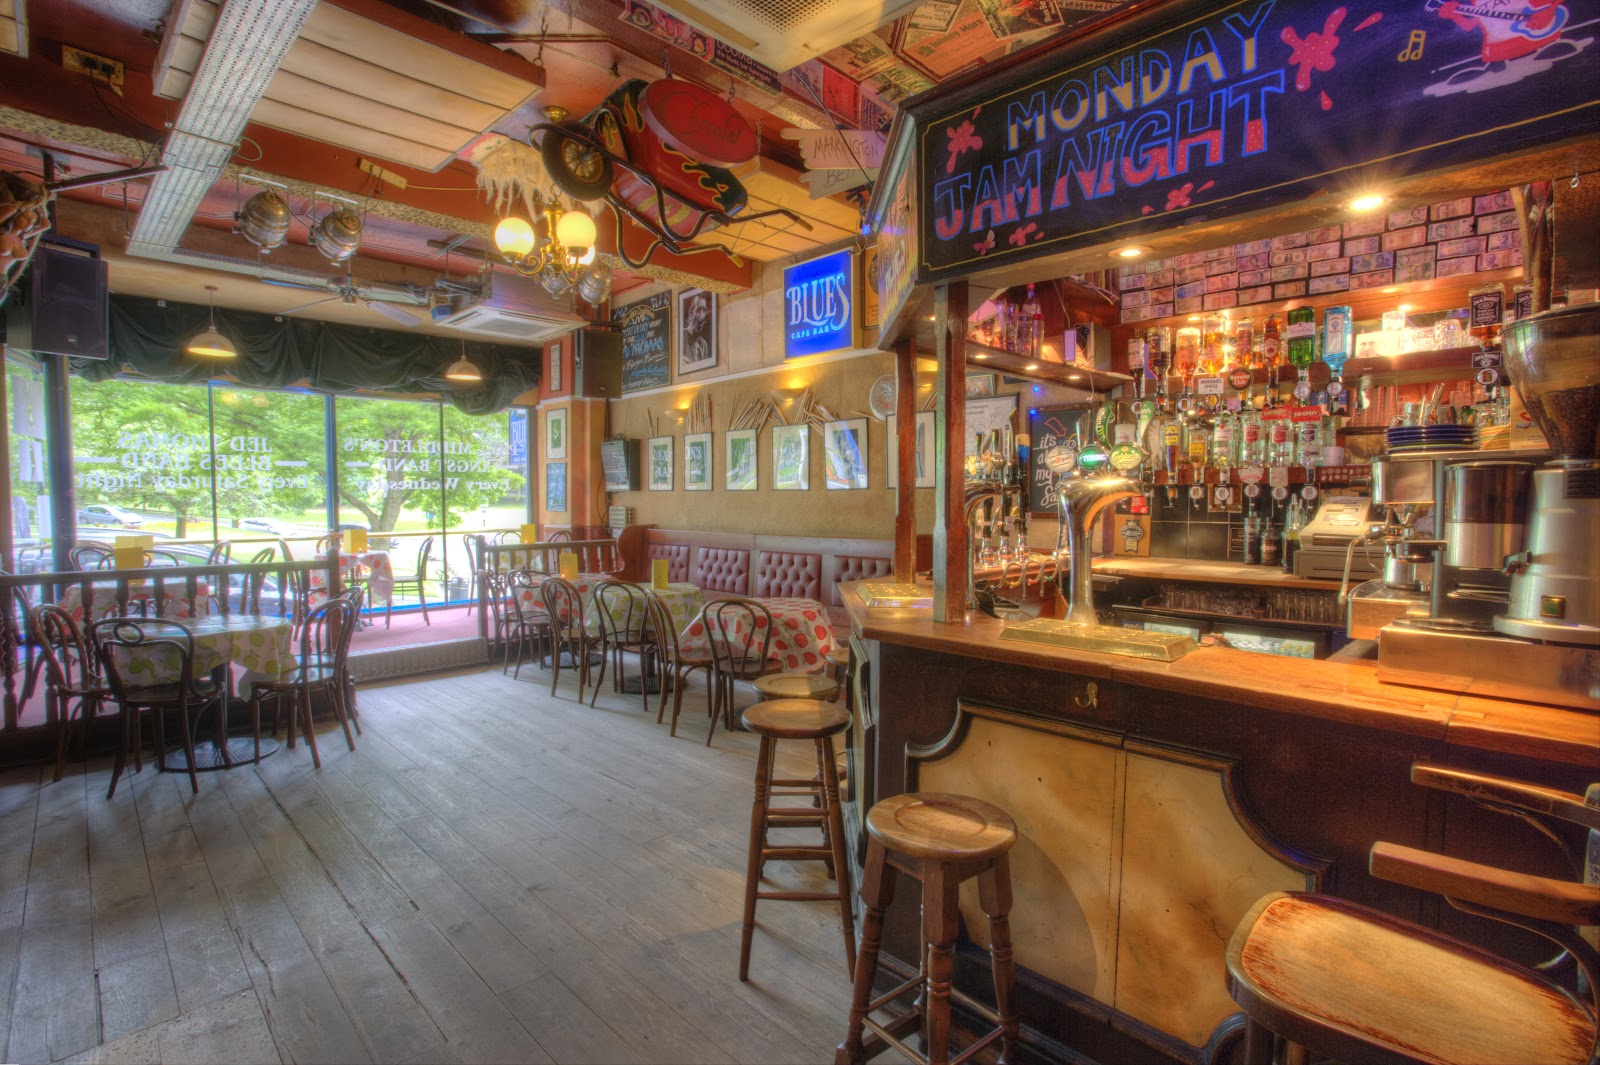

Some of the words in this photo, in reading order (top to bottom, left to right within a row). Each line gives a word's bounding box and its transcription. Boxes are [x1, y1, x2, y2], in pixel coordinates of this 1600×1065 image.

[929, 31, 960, 48] Johnny
[1008, 0, 1277, 151] MONDAY
[934, 149, 1042, 241] JAM
[1050, 69, 1286, 211] NIGHT
[785, 272, 850, 331] BLUES
[1082, 453, 1107, 462] TUBORG
[1111, 450, 1140, 463] Carlsberg
[1035, 469, 1053, 487] my
